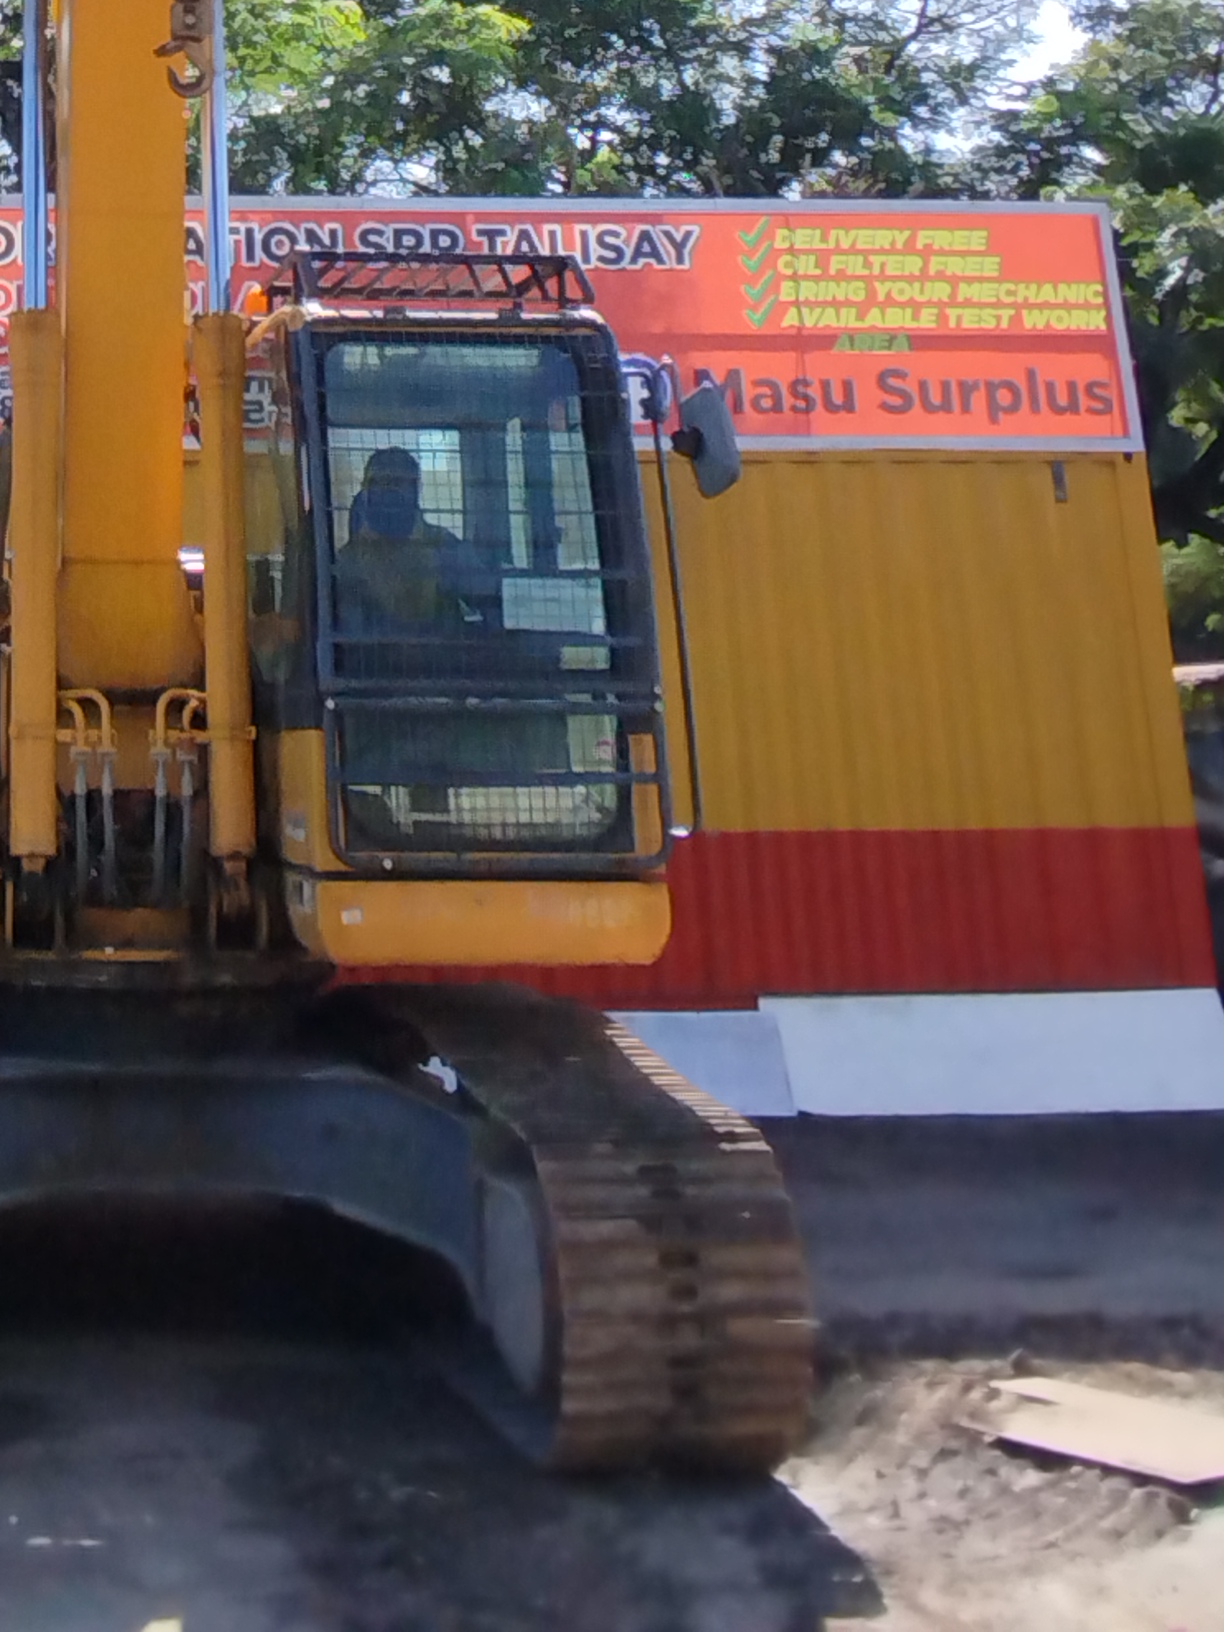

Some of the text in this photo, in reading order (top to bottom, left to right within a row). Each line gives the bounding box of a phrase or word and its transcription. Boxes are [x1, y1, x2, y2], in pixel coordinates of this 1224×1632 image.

[475, 225, 697, 266] TALISAY
[774, 228, 988, 250] DELIVERY FREE
[777, 254, 1000, 276] OIL FILTER FREE
[779, 281, 1104, 304] BRING YOUR MECHANIC
[780, 307, 1108, 330] AVAILABLE TEST WORK
[833, 333, 912, 352] AREA
[877, 368, 1114, 424] Surplus
